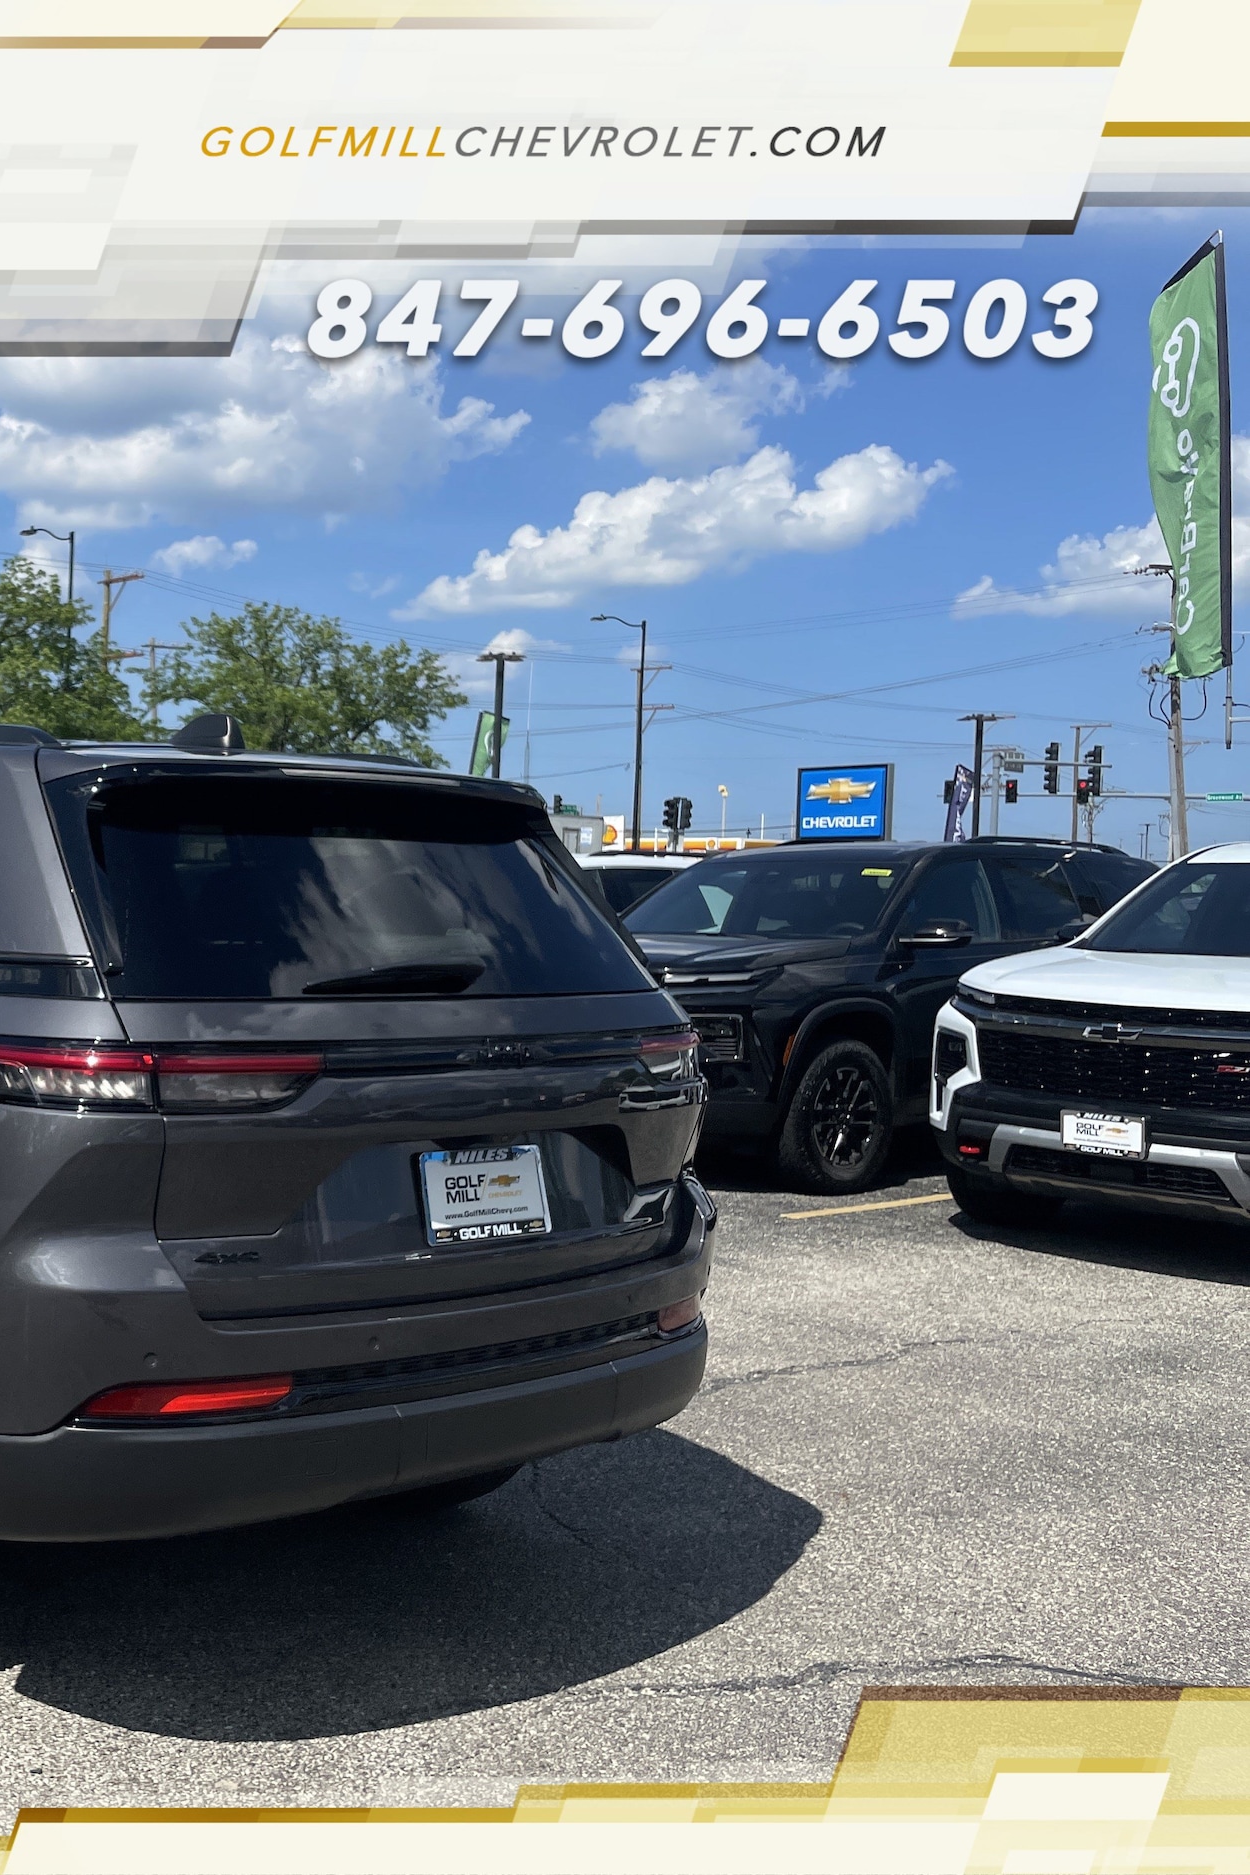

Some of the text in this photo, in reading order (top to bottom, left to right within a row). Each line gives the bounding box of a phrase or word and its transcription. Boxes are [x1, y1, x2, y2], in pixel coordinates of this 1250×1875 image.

[802, 815, 878, 829] CHEVROLET
[454, 1147, 509, 1164] NILES
[445, 1174, 486, 1190] GOLF
[446, 1189, 481, 1204] MILL
[459, 1225, 492, 1240] GOLF
[492, 1223, 522, 1237] MILL
